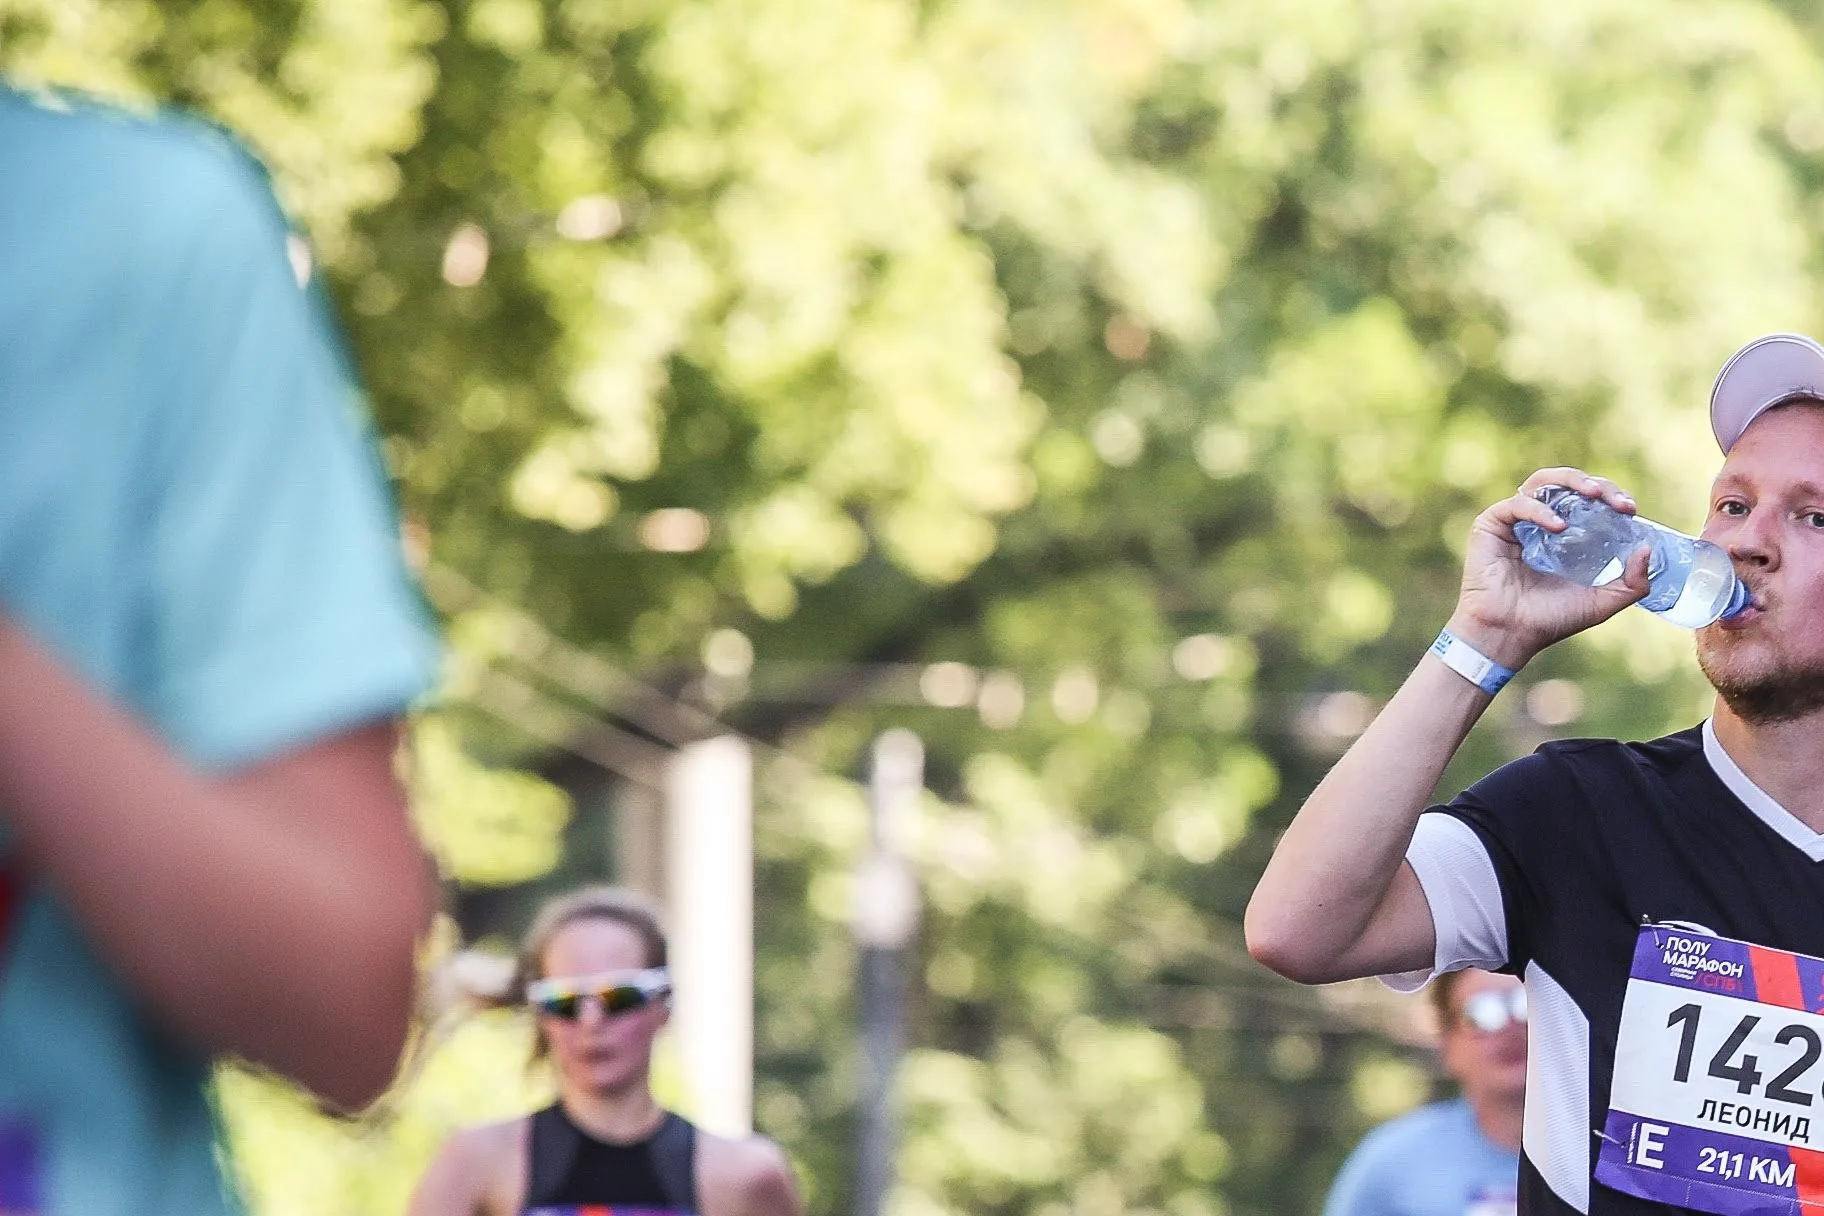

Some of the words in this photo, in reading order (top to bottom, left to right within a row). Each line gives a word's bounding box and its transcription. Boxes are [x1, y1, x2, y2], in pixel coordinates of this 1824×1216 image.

[1665, 936, 1712, 956] ПОЛУ
[1662, 950, 1744, 978] МАРАФОН
[1697, 1099, 1810, 1143] ЛЕОНИД
[1696, 1147, 1745, 1181] 21,1
[1748, 1156, 1797, 1188] КМ
